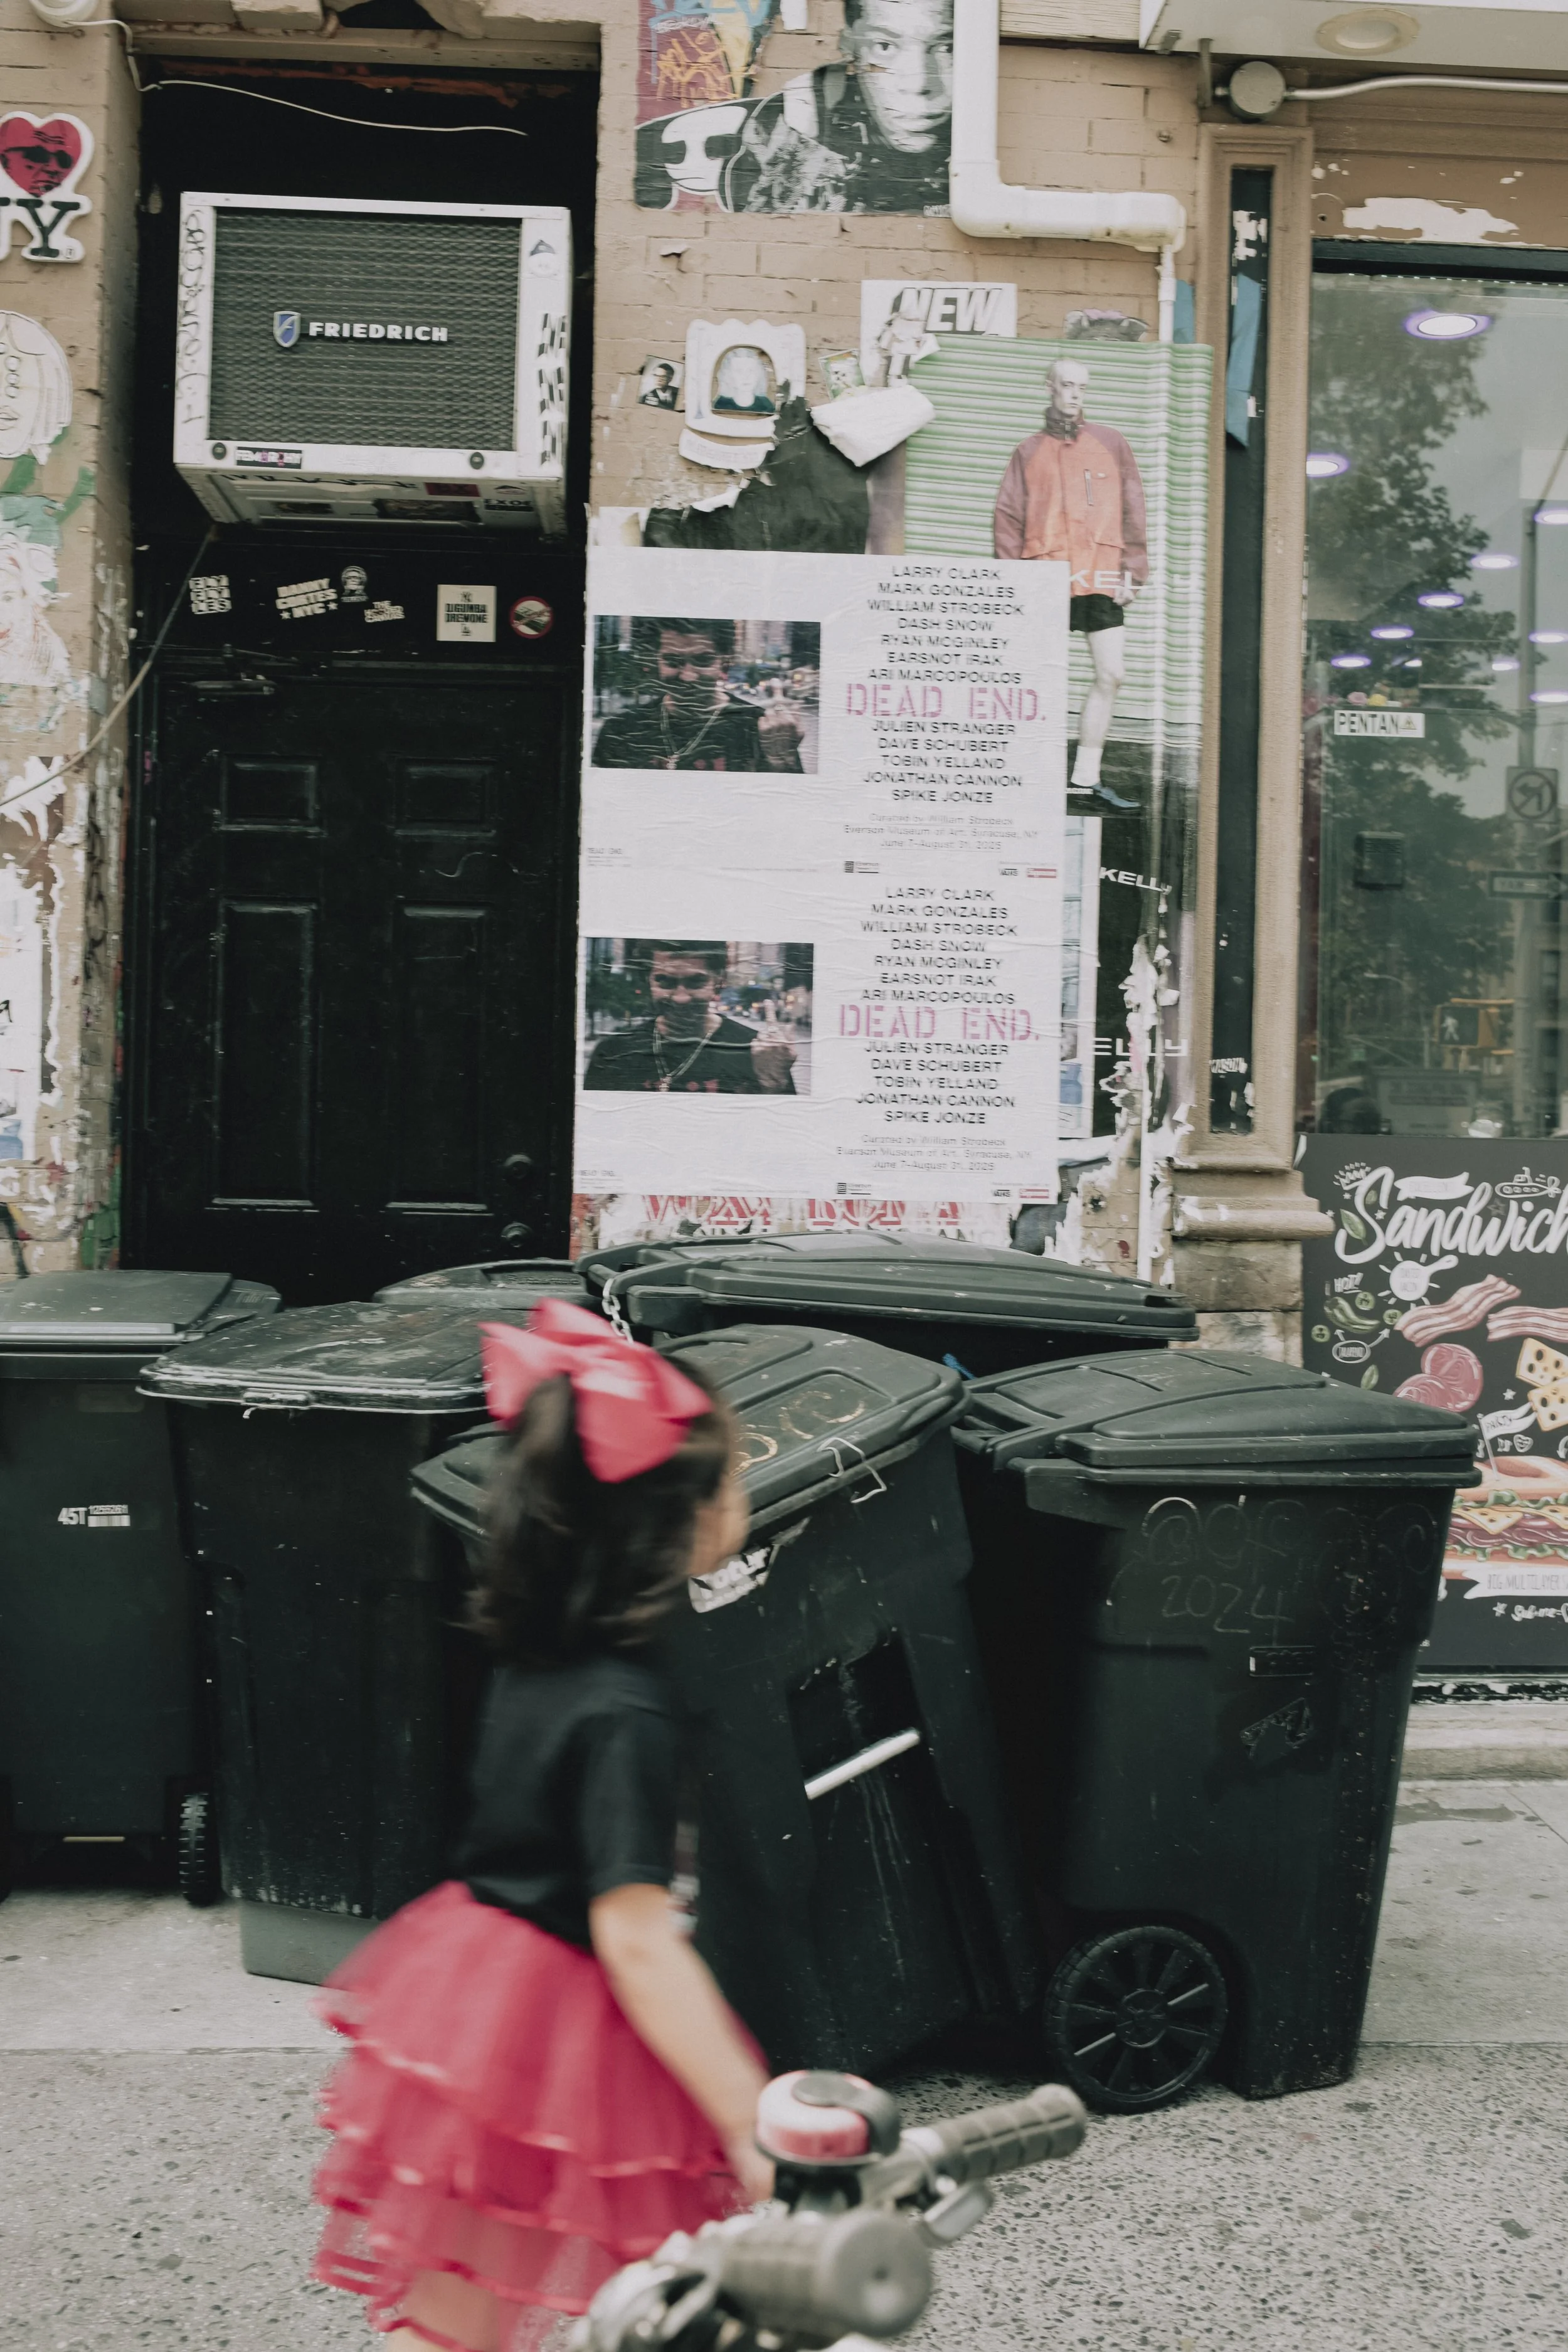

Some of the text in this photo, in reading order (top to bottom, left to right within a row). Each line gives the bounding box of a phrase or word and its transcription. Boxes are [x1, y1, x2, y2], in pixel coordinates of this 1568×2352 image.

[0, 197, 80, 258] Y
[898, 287, 1004, 332] NEW
[309, 322, 448, 341] FRIEDRICH
[893, 566, 1002, 580] LARRY CLARK
[879, 582, 1015, 598] MARK GONZALES
[867, 600, 1025, 615] WILLIAM STROBECK
[898, 618, 992, 632] DASH SNOW
[881, 635, 1008, 649] RYAN MCGINLEY
[888, 652, 1003, 665] EARSNOT IRAK
[868, 669, 1021, 684] ARI MARCOPOULOS
[846, 683, 1046, 721] DEAD END.
[872, 721, 1015, 735] JULIEN STRANGER
[879, 738, 1009, 752] DAVE SCHUBERT
[880, 755, 1004, 769] TOBIN YELLAND
[864, 772, 1022, 787] JONATHAN CANNON
[893, 789, 992, 803] SPIKE JONZE
[889, 826, 930, 836] Museum
[1099, 866, 1172, 895] KELLY
[886, 887, 995, 901] LARRY CLARK
[871, 904, 1007, 919] MARK GONZALES
[861, 921, 1017, 936] WILLIAM STROBECK
[891, 939, 986, 952] DASH SNOW
[874, 955, 1002, 970] RYAN MCGINLEY
[881, 973, 997, 987] EARSNOT IRAK
[861, 989, 1015, 1004] ARI MARCOPOULOS
[839, 1004, 1039, 1041] DEAD END.
[865, 1041, 1009, 1055] JULIEN STRANGER
[871, 1059, 1002, 1072] DAVE SCHUBERT
[874, 1076, 998, 1089] TOBIN YELLAND
[856, 1093, 1015, 1107] JONATHAN CANNON
[884, 1111, 985, 1124] SPIKE JONZE
[881, 1147, 922, 1157] Museum
[58, 1507, 87, 1525] 45T
[1487, 1574, 1502, 1589] BIG
[1506, 1574, 1560, 1591] MULTILAYER
[1162, 1574, 1296, 1646] 2024
